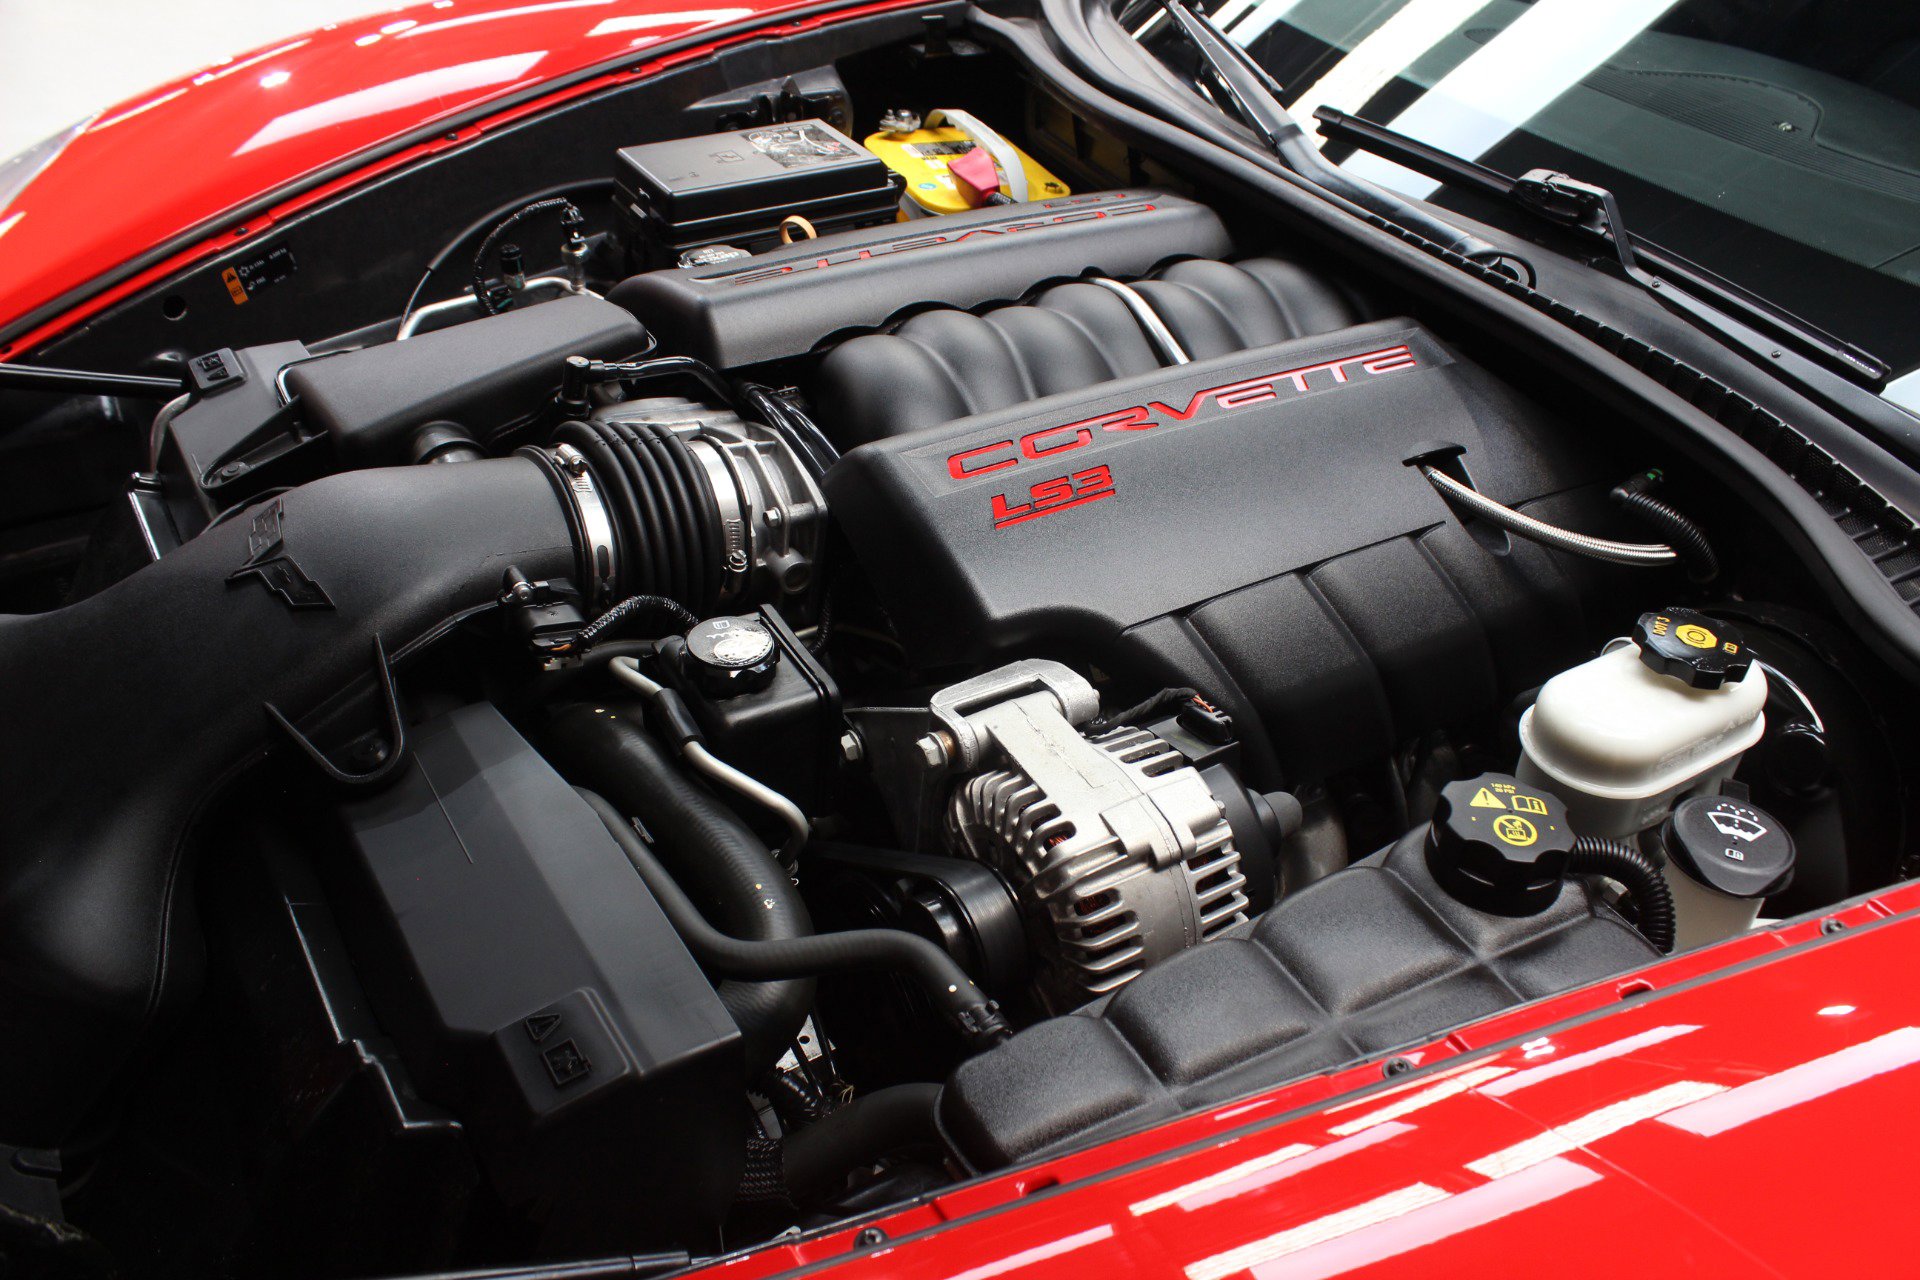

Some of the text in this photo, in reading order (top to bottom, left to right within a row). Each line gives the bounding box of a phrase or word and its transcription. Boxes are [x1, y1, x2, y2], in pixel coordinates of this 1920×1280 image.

[947, 344, 1416, 480] CORVETTE
[990, 463, 1114, 521] LS3
[1653, 620, 1668, 636] DOT
